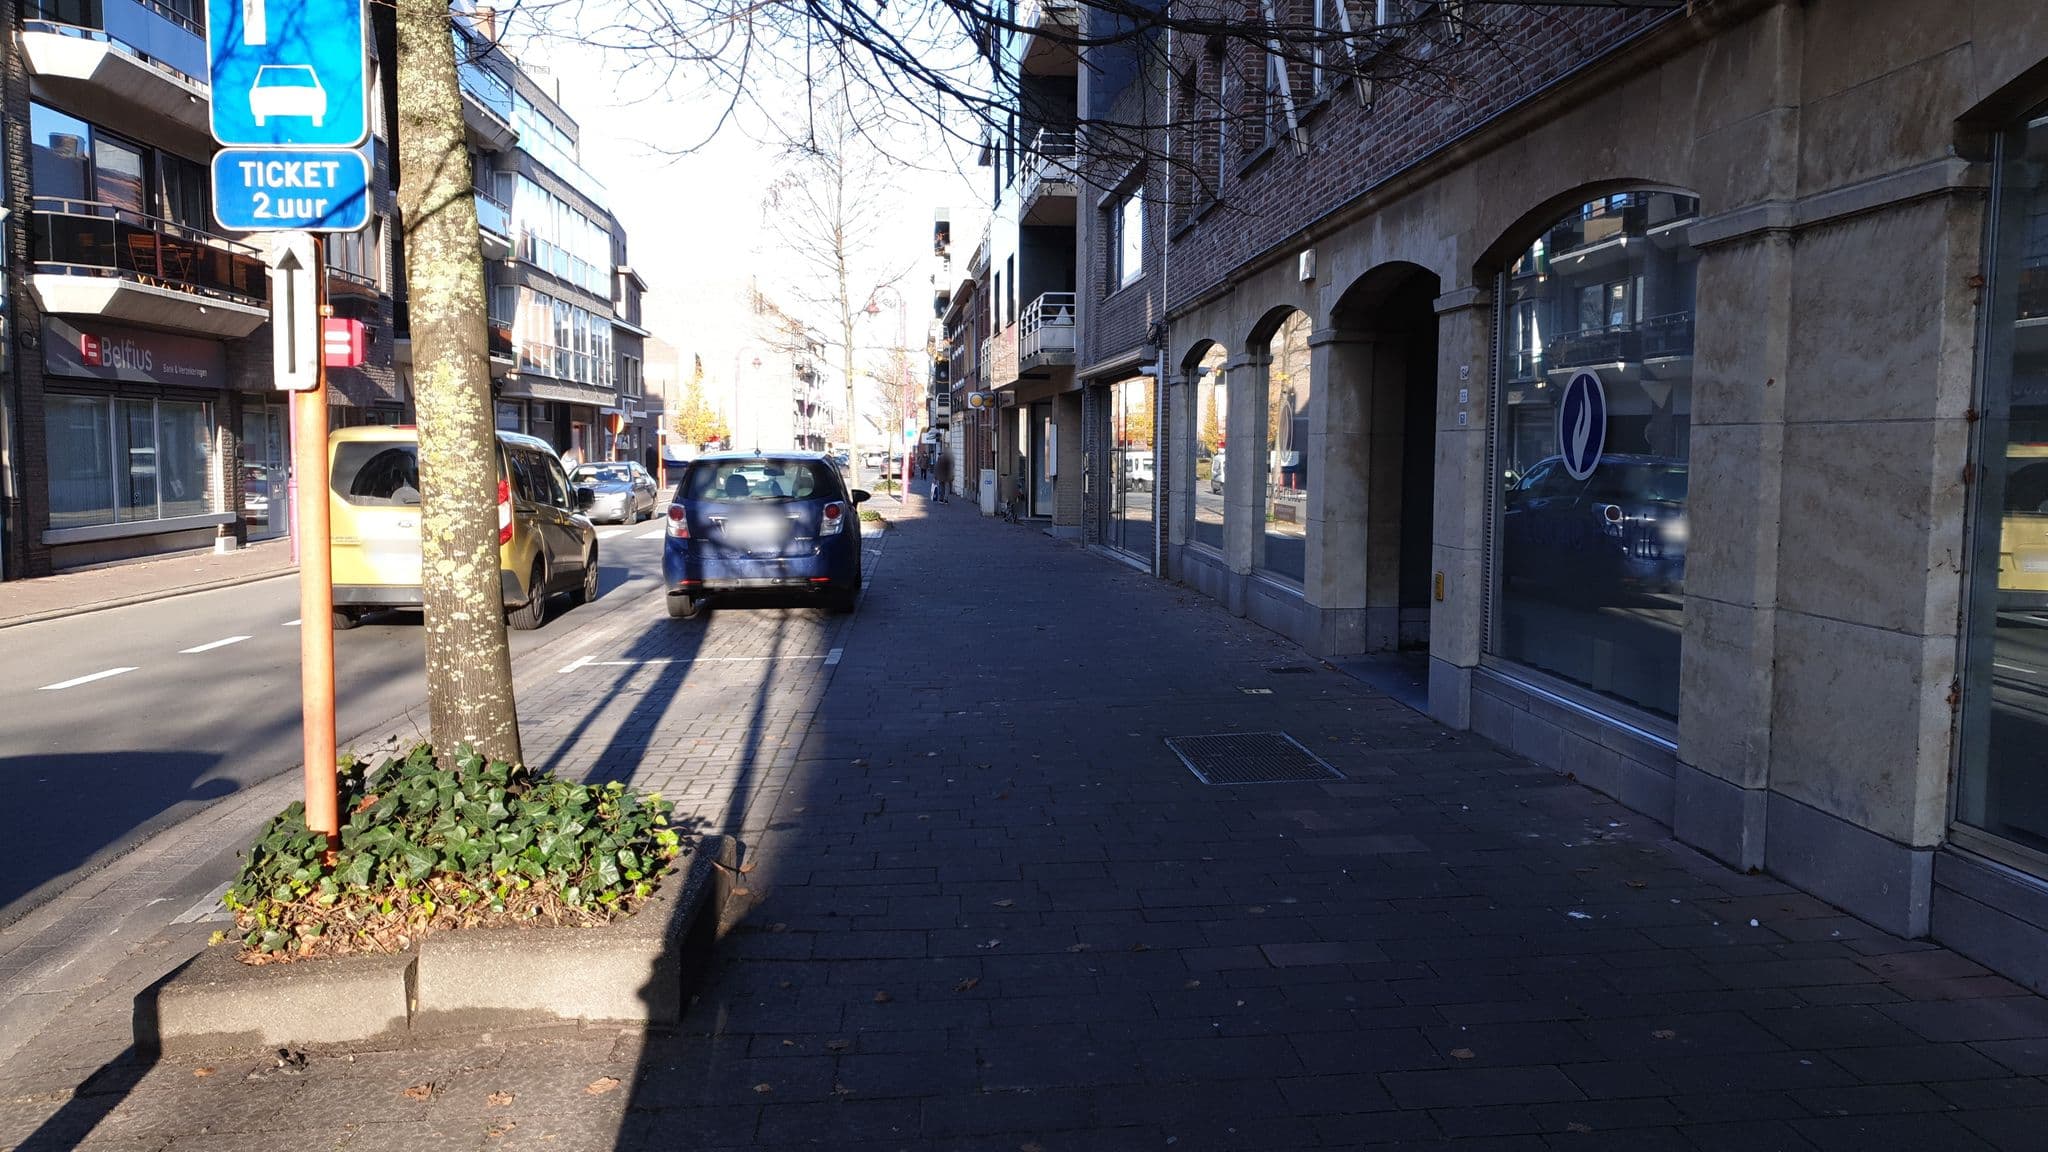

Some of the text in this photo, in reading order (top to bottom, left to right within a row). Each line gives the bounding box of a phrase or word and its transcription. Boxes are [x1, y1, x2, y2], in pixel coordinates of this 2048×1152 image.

[239, 161, 340, 188] TICKET
[252, 191, 328, 219] 2 uur
[101, 337, 153, 371] Belfius
